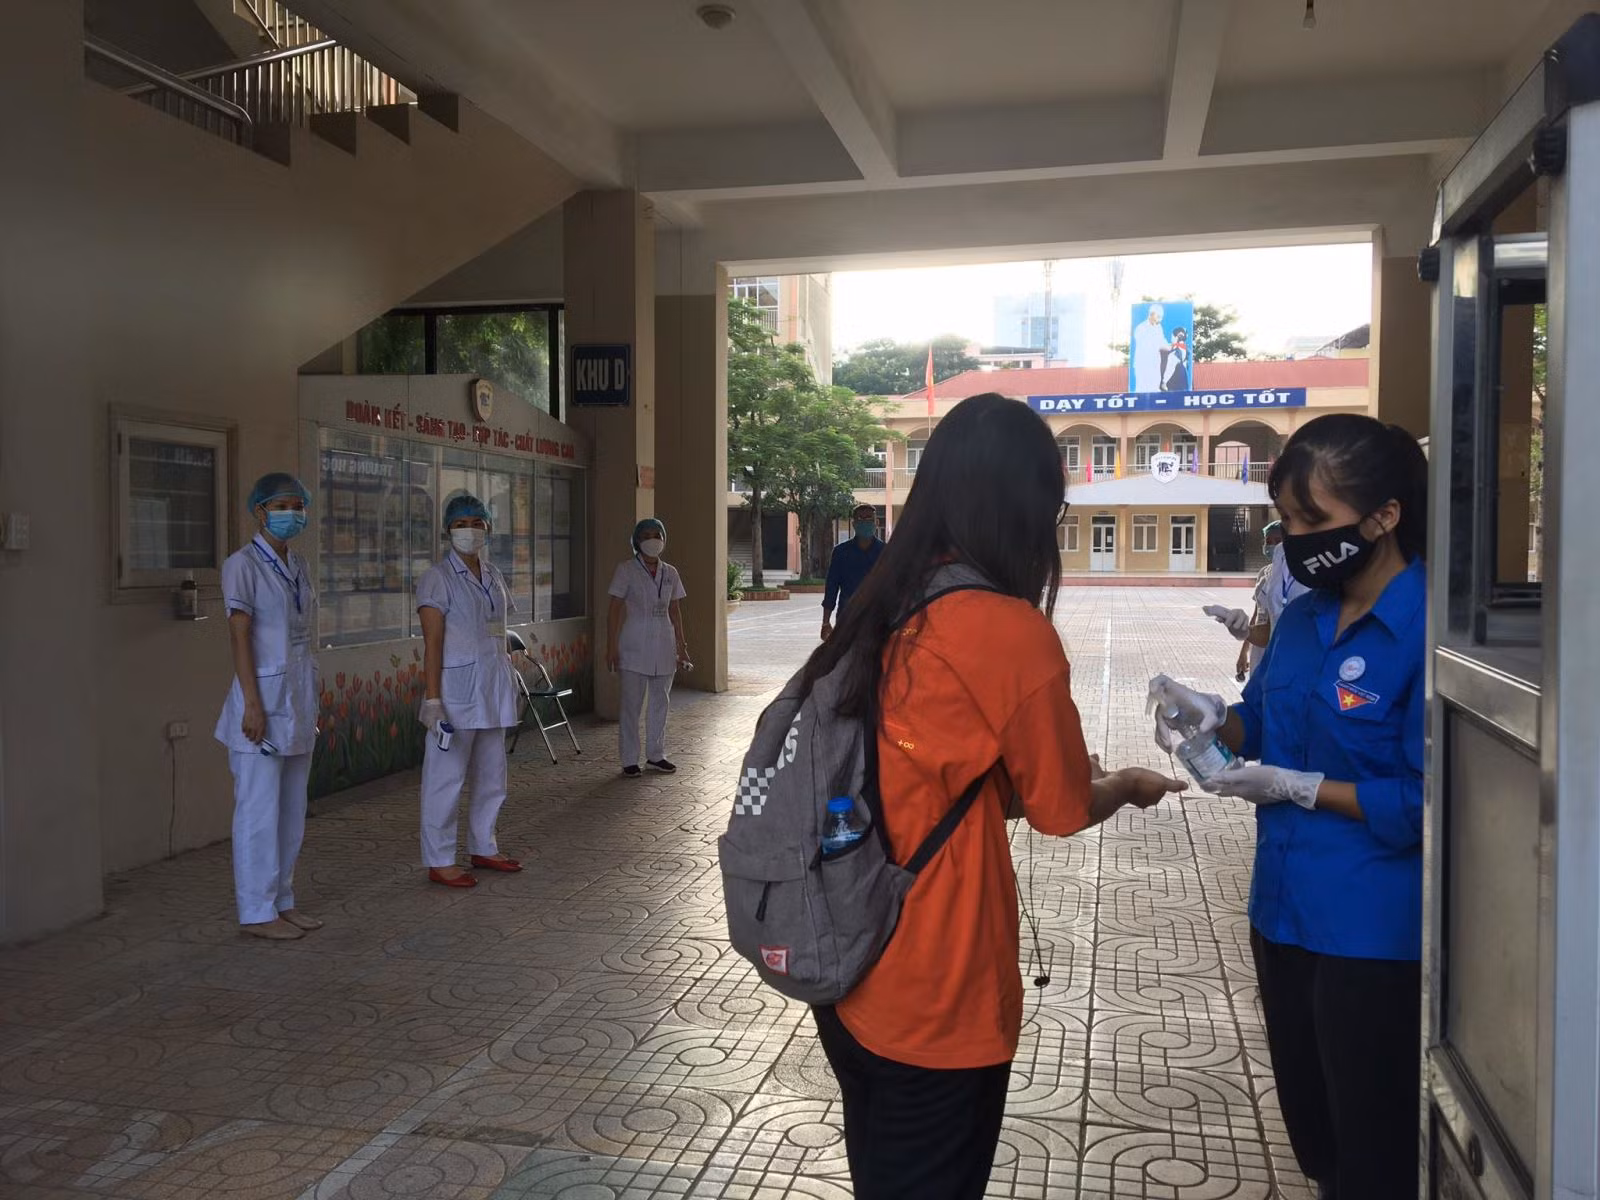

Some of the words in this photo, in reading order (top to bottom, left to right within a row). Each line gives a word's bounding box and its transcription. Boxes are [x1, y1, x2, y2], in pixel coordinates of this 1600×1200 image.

[576, 358, 609, 391] KHU
[614, 358, 625, 391] D
[1039, 398, 1085, 412] DẠY
[1093, 393, 1139, 409] TỐT
[1183, 394, 1235, 408] HỌC
[1243, 388, 1291, 405] TỐT
[385, 403, 407, 431] KẾT
[1302, 541, 1360, 575] FILA
